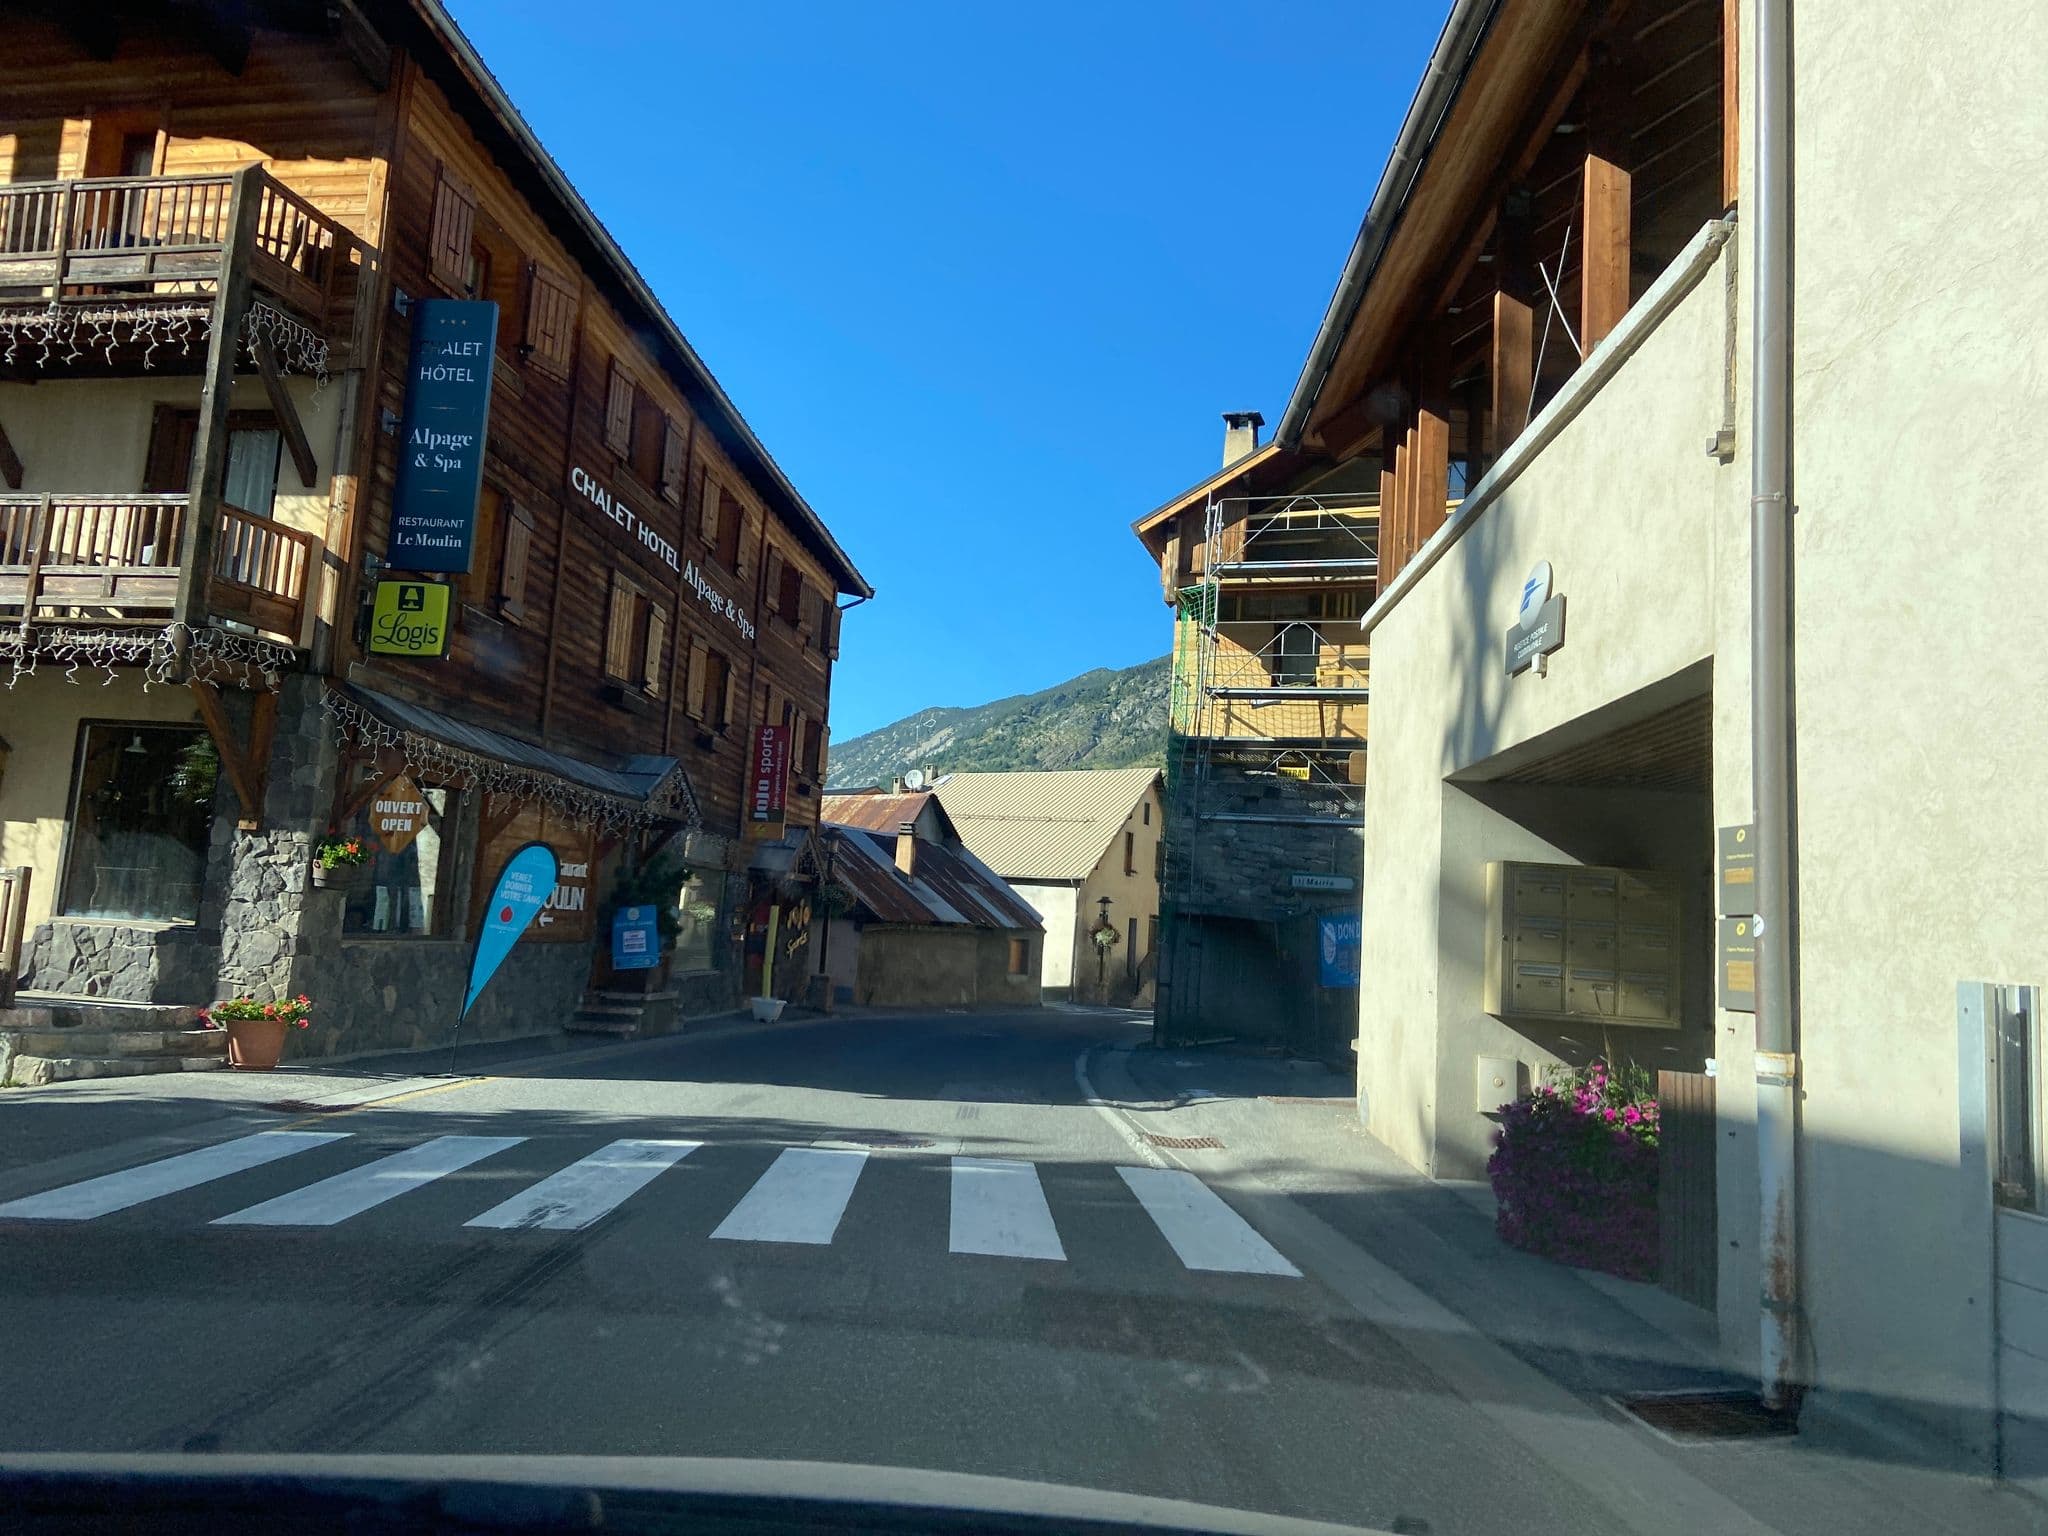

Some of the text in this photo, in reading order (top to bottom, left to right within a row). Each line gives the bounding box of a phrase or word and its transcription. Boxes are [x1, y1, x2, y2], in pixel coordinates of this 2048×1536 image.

[422, 341, 483, 357] ALET
[420, 363, 475, 382] HÔTEL
[408, 427, 473, 452] Alpage
[414, 452, 464, 473] & Spa
[398, 516, 465, 529] RESTAURANT
[396, 532, 463, 548] Le Moulin
[571, 467, 756, 640] CHALET HOTEL Alpage & Spa
[373, 612, 439, 651] Logis
[760, 728, 775, 774] sports
[375, 800, 423, 815] OUVERT
[381, 818, 412, 832] OPEN
